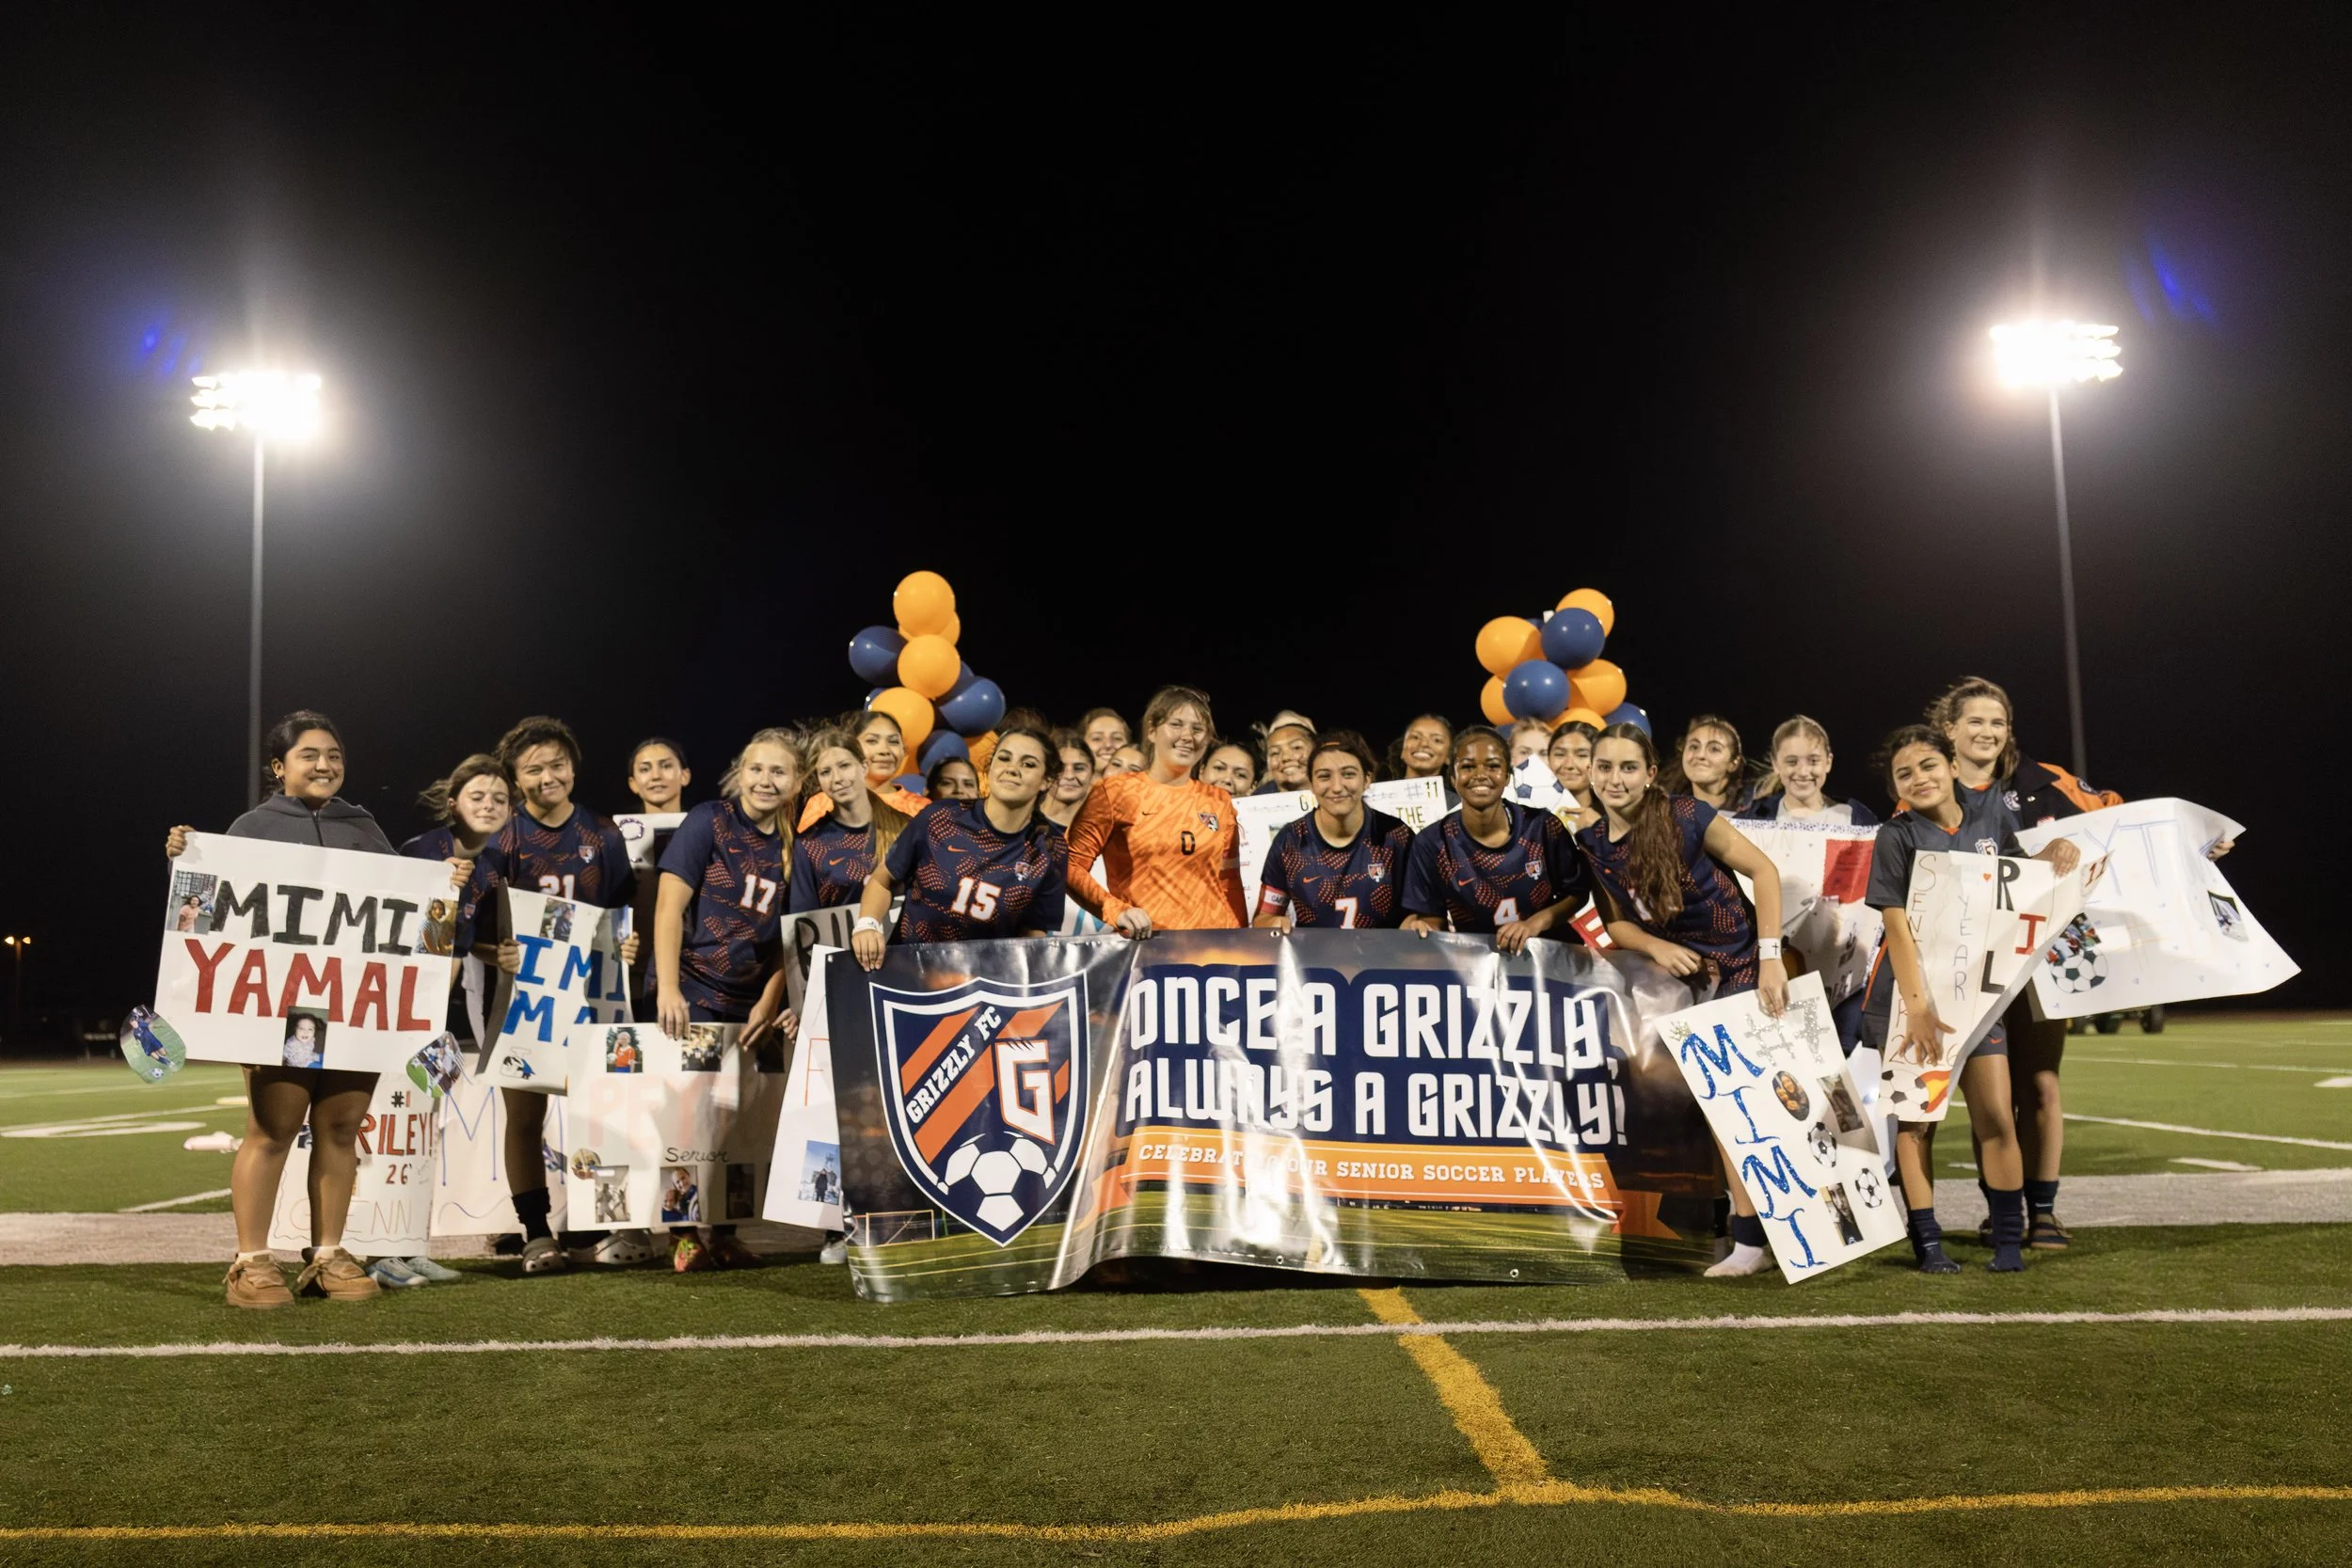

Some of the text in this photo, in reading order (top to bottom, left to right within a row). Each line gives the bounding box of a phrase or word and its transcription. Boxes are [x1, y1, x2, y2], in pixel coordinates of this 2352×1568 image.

[210, 879, 419, 956] MIMI
[739, 874, 777, 915] 17
[950, 876, 1001, 923] 15
[1335, 895, 1359, 929] 7
[1494, 897, 1520, 927] 4
[184, 939, 431, 1032] YAMAL
[1130, 975, 1279, 1051] ONCE
[1302, 982, 1337, 1056] A
[905, 1006, 1002, 1125] GRIZZLY FC
[994, 1038, 1056, 1146] G
[1355, 1071, 1386, 1135] A
[1407, 1072, 1628, 1146] GRIZZLY!
[1336, 1161, 1414, 1180] SENIOR
[1422, 1164, 1506, 1183] SOCCER
[1513, 1166, 1605, 1189] PLAYERS
